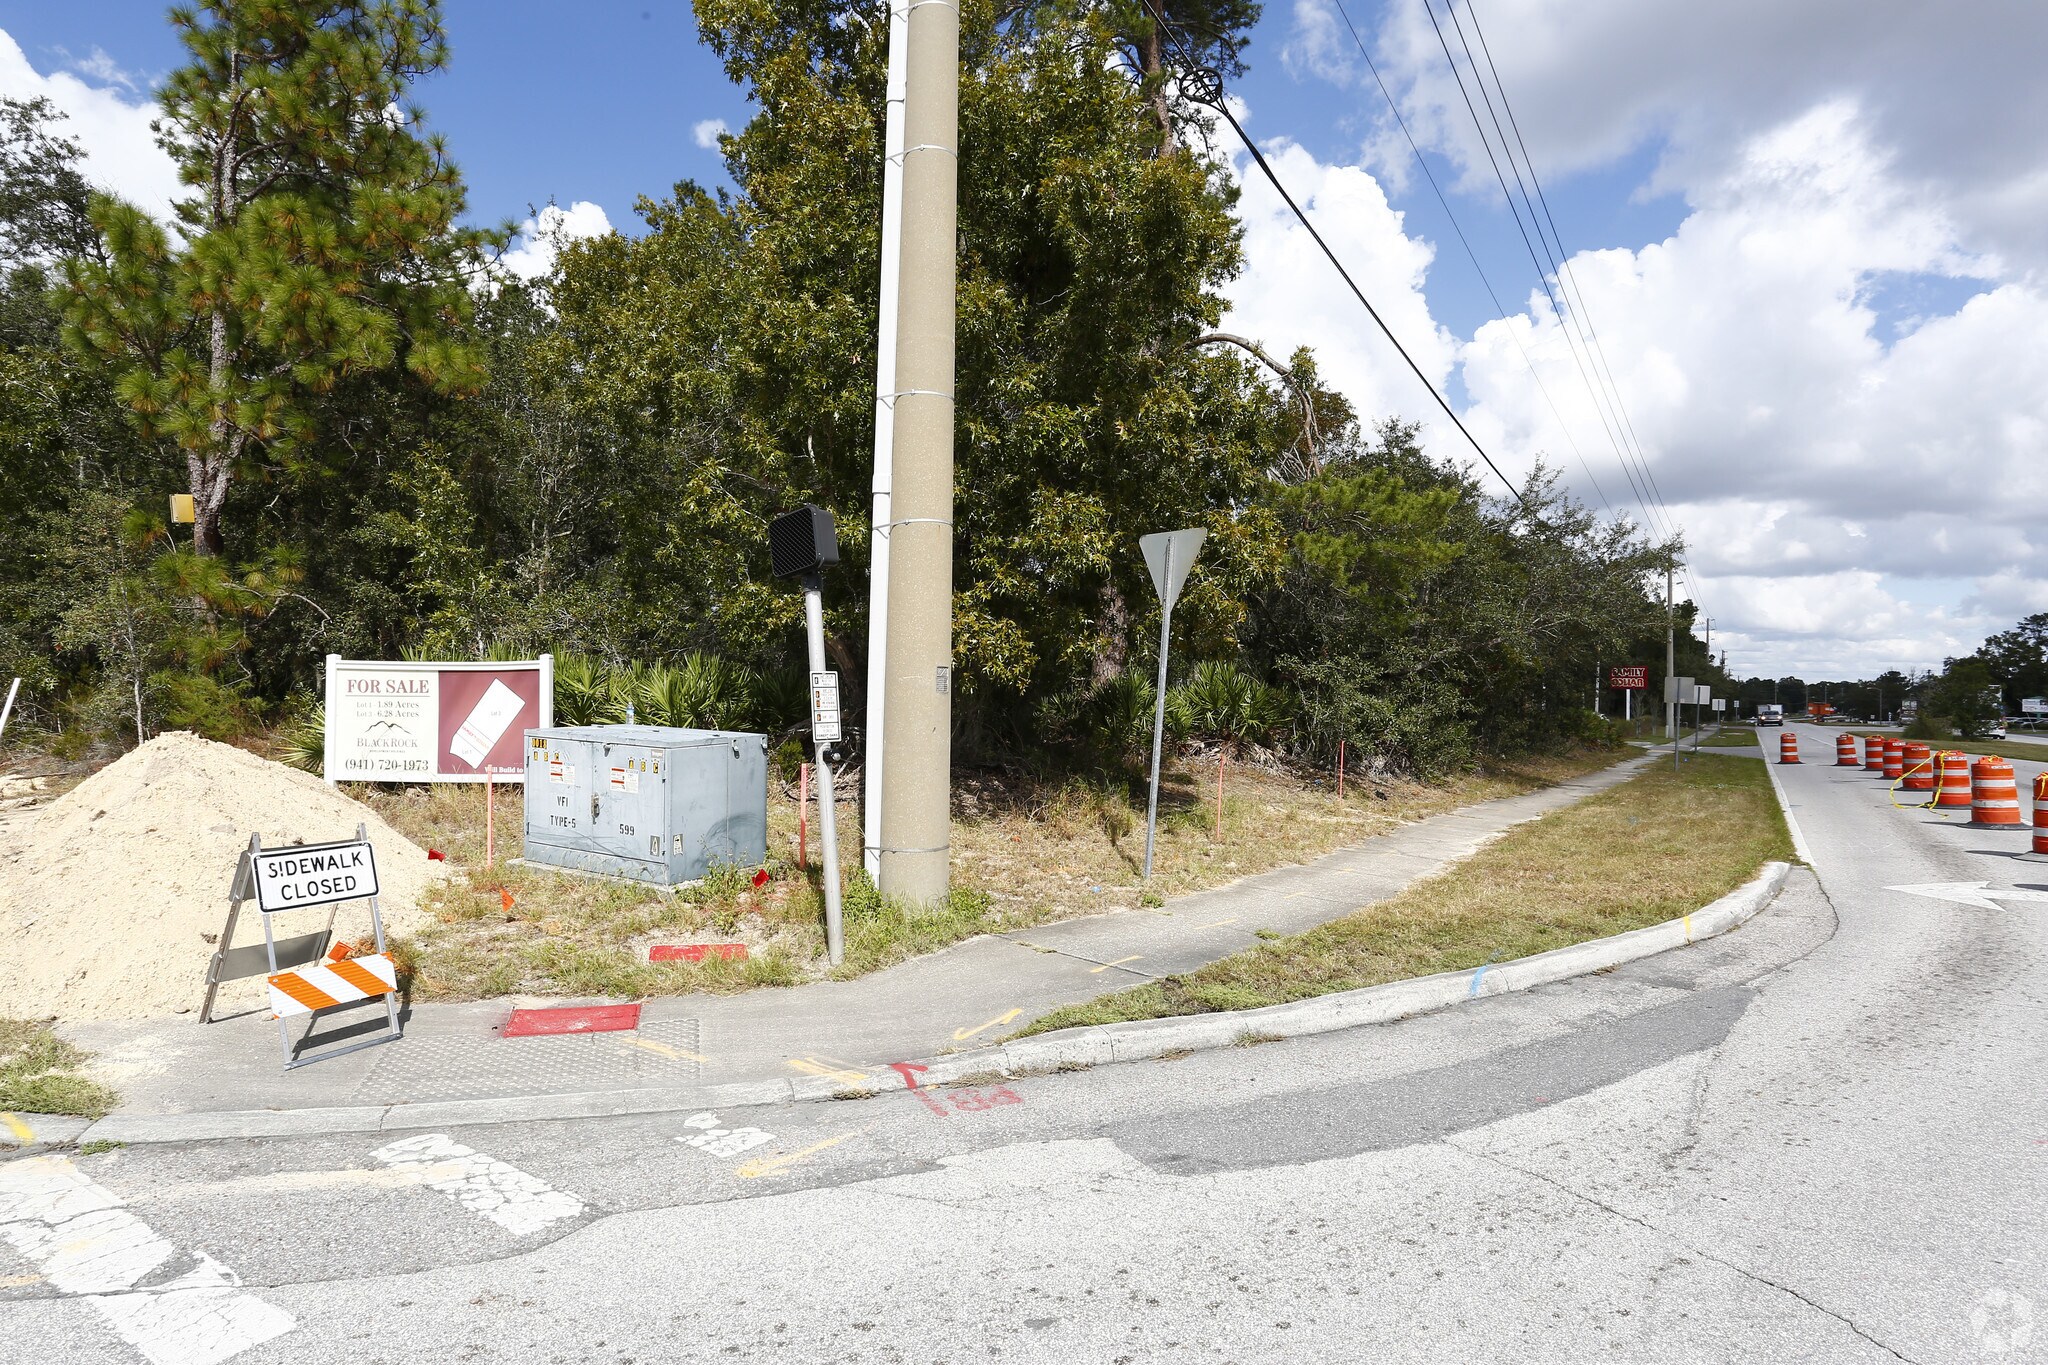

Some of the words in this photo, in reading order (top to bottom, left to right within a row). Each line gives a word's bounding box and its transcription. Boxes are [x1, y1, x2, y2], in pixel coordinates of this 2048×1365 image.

[1611, 667, 1645, 677] FAMILY
[347, 679, 381, 693] FOR
[386, 679, 429, 694] SALE
[1610, 677, 1645, 688] DOLLAR
[377, 710, 393, 718] 6.28
[395, 710, 420, 718] Acres
[345, 758, 374, 771] (941)
[378, 759, 429, 771] 720-1973
[550, 815, 576, 828] TYPE-5
[619, 823, 635, 836] 599
[268, 851, 363, 879] SIDEWALK
[281, 875, 357, 900] CLOSED
